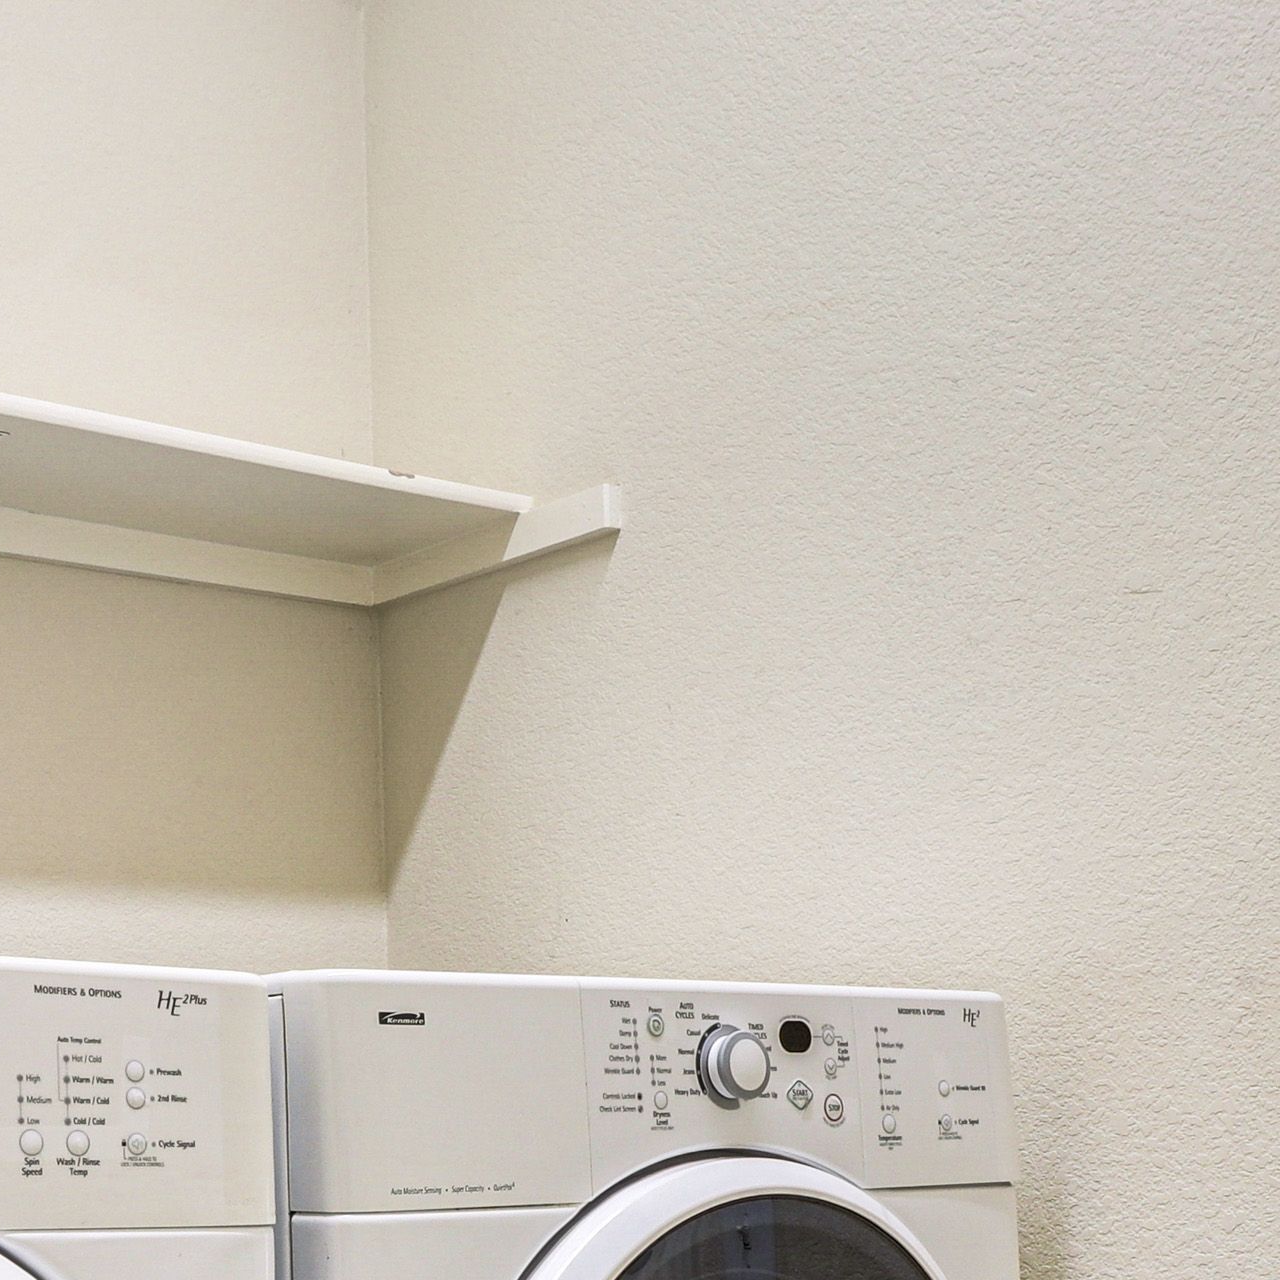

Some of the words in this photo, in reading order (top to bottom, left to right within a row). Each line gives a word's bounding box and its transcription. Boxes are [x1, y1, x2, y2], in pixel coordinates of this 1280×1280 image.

[34, 984, 77, 997] MODIFIERS
[80, 988, 86, 997] &
[88, 987, 122, 999] OPTIONS
[610, 1000, 630, 1009] STATUS
[680, 1002, 694, 1010] AUTO
[675, 1011, 694, 1019] CYCLES
[387, 1017, 424, 1025] Kenmore
[72, 1055, 83, 1063] Hot
[88, 1055, 102, 1063] Cold
[156, 1068, 182, 1076] Prewash
[26, 1074, 40, 1084] High
[72, 1076, 90, 1084] Warm
[792, 1089, 808, 1097] START
[26, 1096, 52, 1104] Medium
[96, 1097, 110, 1105] Cold
[171, 1095, 187, 1103] Rinse
[73, 1117, 87, 1125] Cold
[92, 1118, 105, 1126] Cold
[158, 1140, 175, 1149] Cycle
[177, 1140, 196, 1150] Signal
[24, 1157, 40, 1167] Spin
[57, 1157, 75, 1166] Wash
[82, 1158, 100, 1166] Rinse
[22, 1168, 43, 1178] Speed
[70, 1168, 88, 1178] Temp
